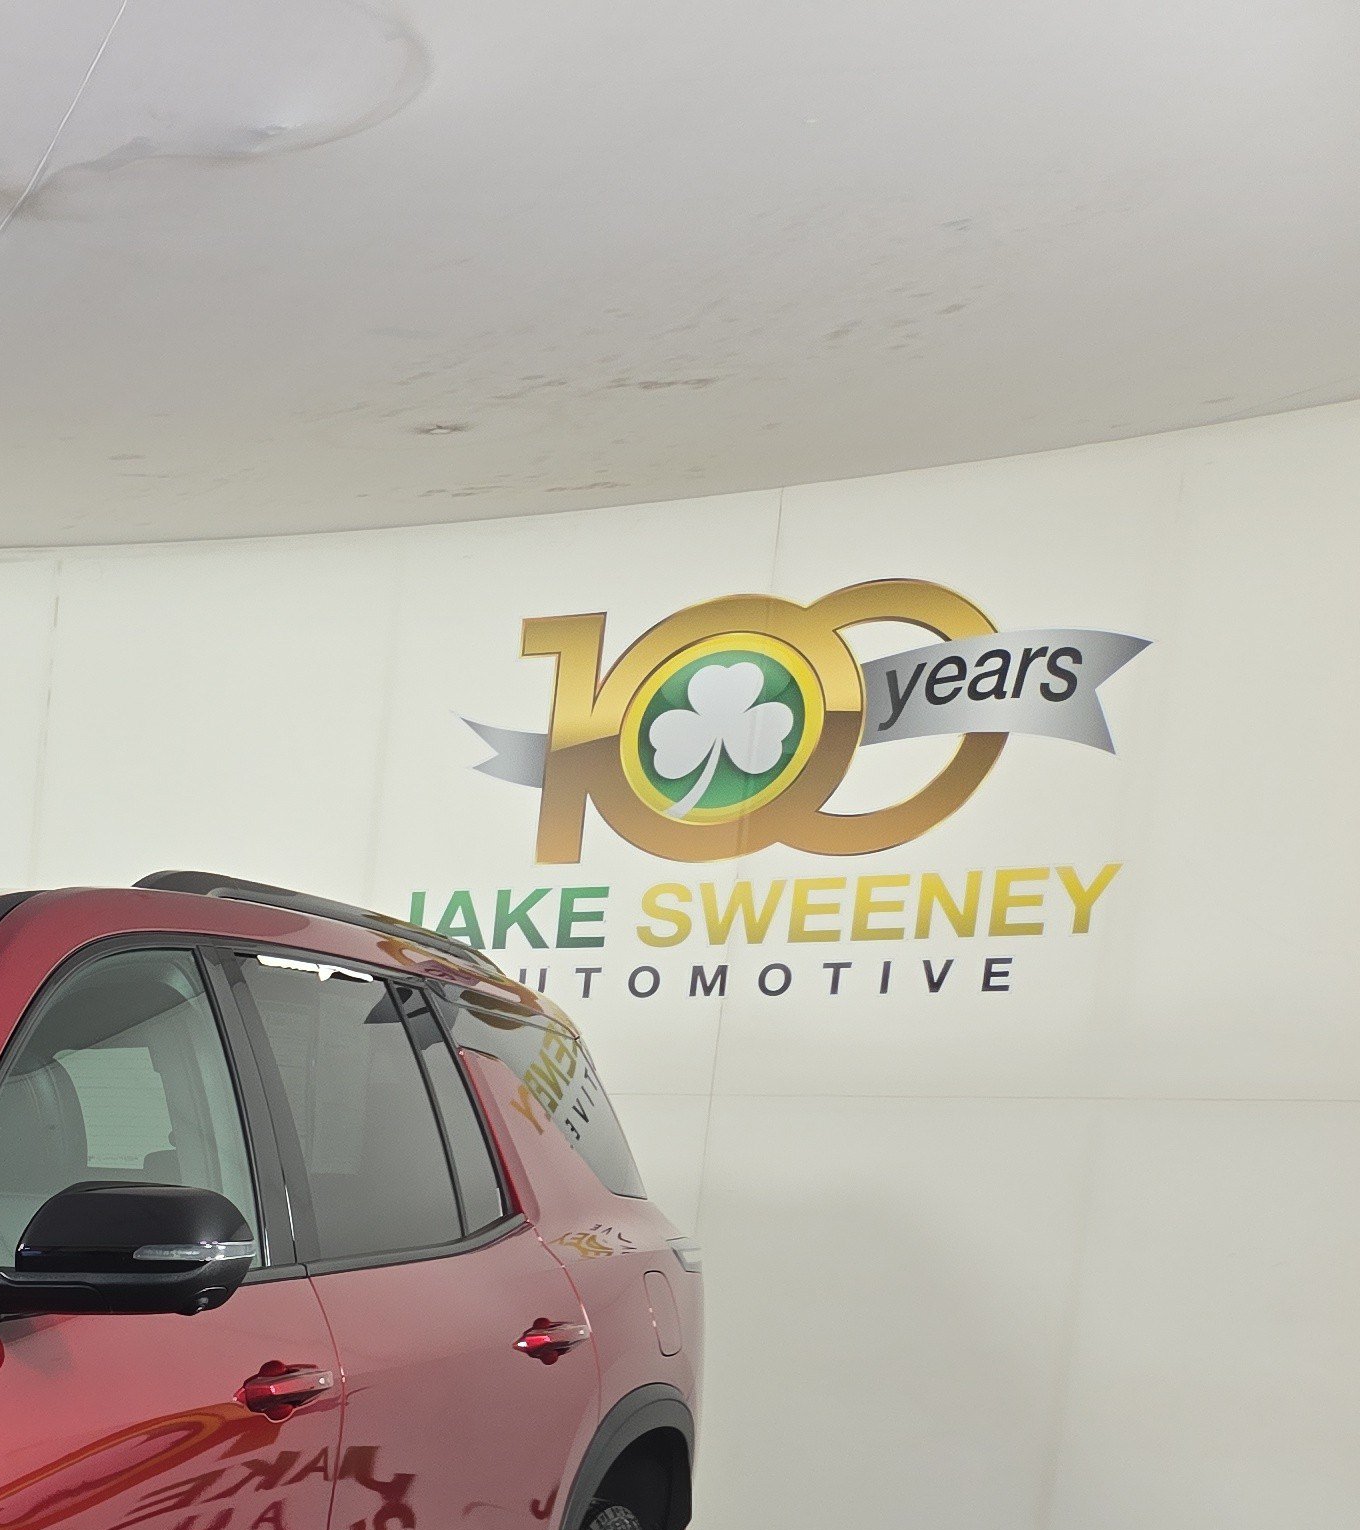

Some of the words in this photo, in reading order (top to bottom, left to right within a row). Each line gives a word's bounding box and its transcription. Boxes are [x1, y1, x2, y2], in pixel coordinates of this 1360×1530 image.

[520, 577, 1009, 864] 100
[878, 644, 1084, 732] years
[636, 863, 1123, 949] SWEENEY
[518, 957, 1015, 999] UTOMOTIVE
